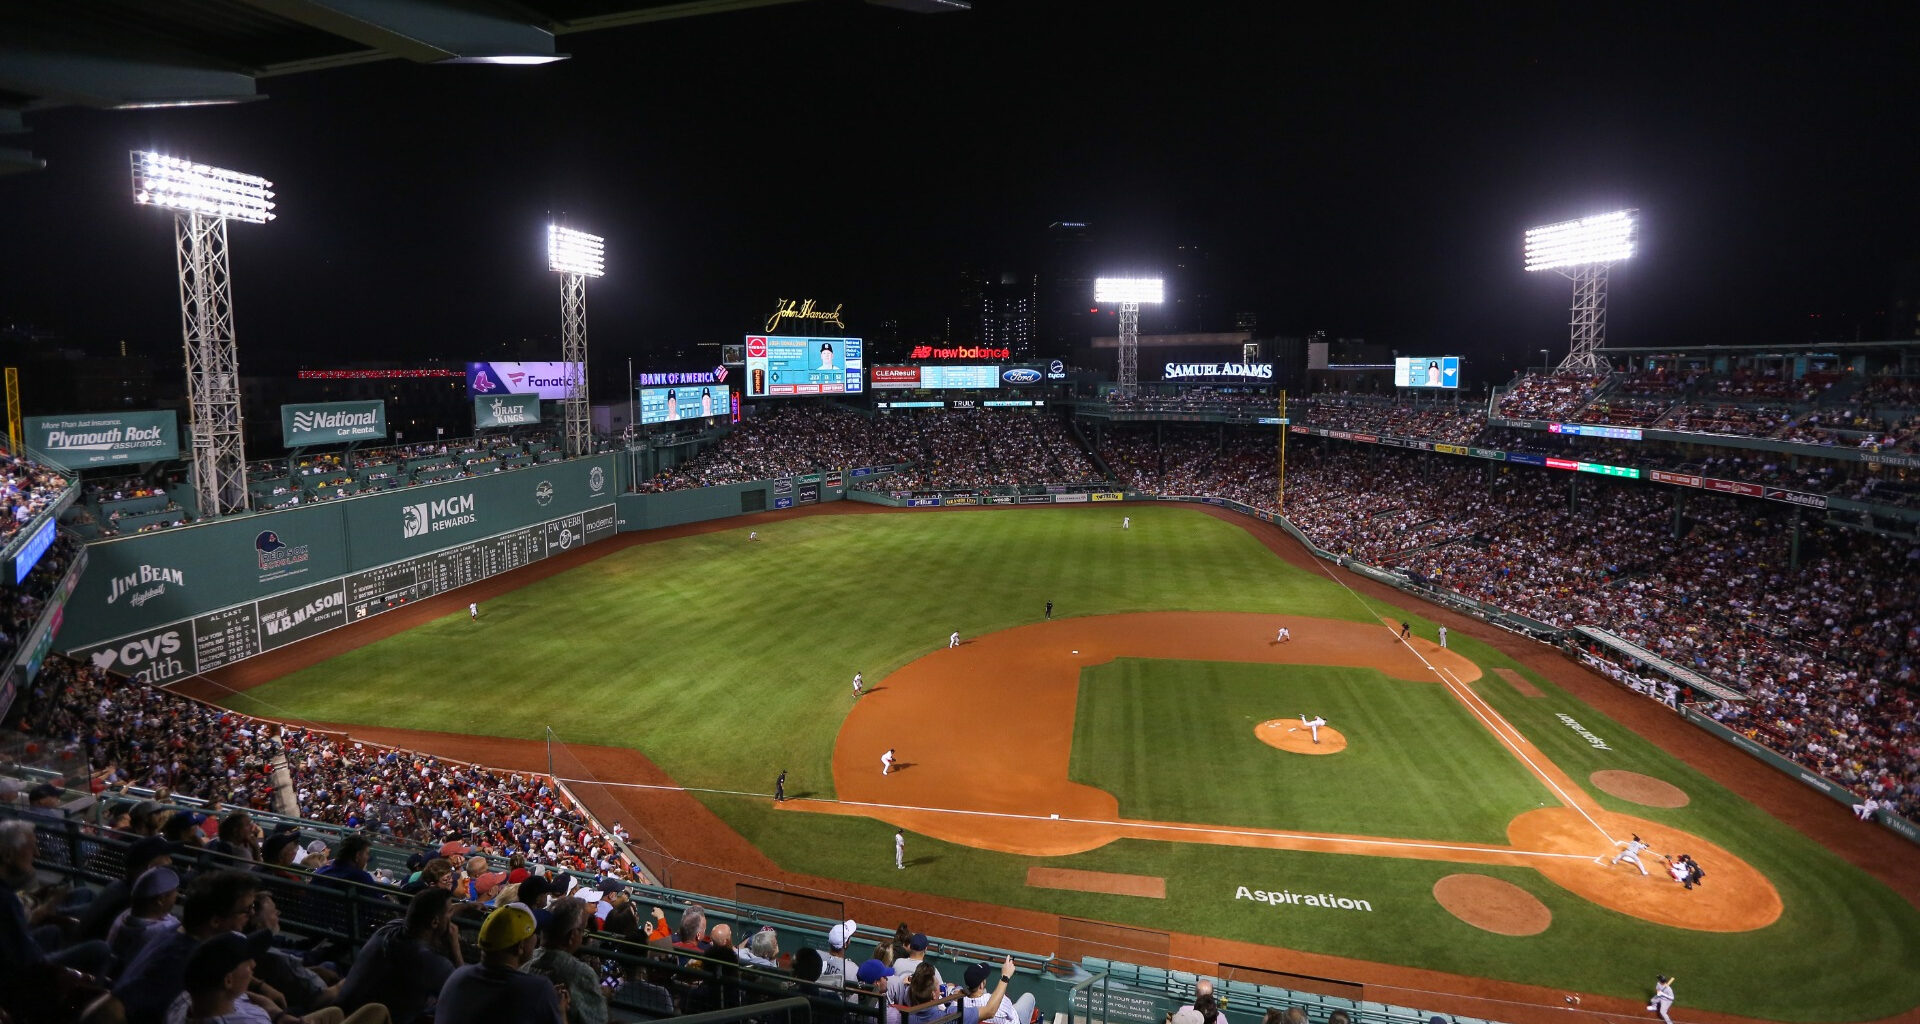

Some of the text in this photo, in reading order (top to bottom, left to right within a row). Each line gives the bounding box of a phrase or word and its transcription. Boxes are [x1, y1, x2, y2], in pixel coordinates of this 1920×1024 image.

[766, 297, 844, 332] John Hancock
[1010, 371, 1034, 381] Ford
[1165, 362, 1272, 378] SAMUEL ADAMS
[640, 372, 714, 385] BANK OF AMERICA
[493, 405, 524, 417] DRAFT
[313, 409, 376, 428] National
[497, 414, 524, 423] KINGS
[47, 425, 161, 447] Plymouth Rock
[352, 426, 374, 434] Rental
[114, 440, 162, 449] assurance
[431, 493, 474, 519] MGM
[1785, 493, 1825, 507] Safelite
[432, 514, 475, 532] REWARDS
[561, 515, 582, 529] WEBB
[586, 516, 613, 531] moderna
[263, 545, 308, 562] RED SOX
[438, 544, 475, 558] AMERICAN LEAGUE
[363, 566, 393, 578] FENWAY
[107, 565, 184, 604] JIM BEAM
[261, 613, 276, 623] WHO
[314, 613, 330, 622] SINCE
[120, 631, 181, 665] CVS
[199, 645, 224, 656] TORONTO
[199, 652, 227, 664] BALTIMORE
[136, 657, 184, 683] alth
[200, 660, 221, 671] BOSTON
[1235, 886, 1372, 912] Aspiration
[1131, 998, 1153, 1006] SAFETY
